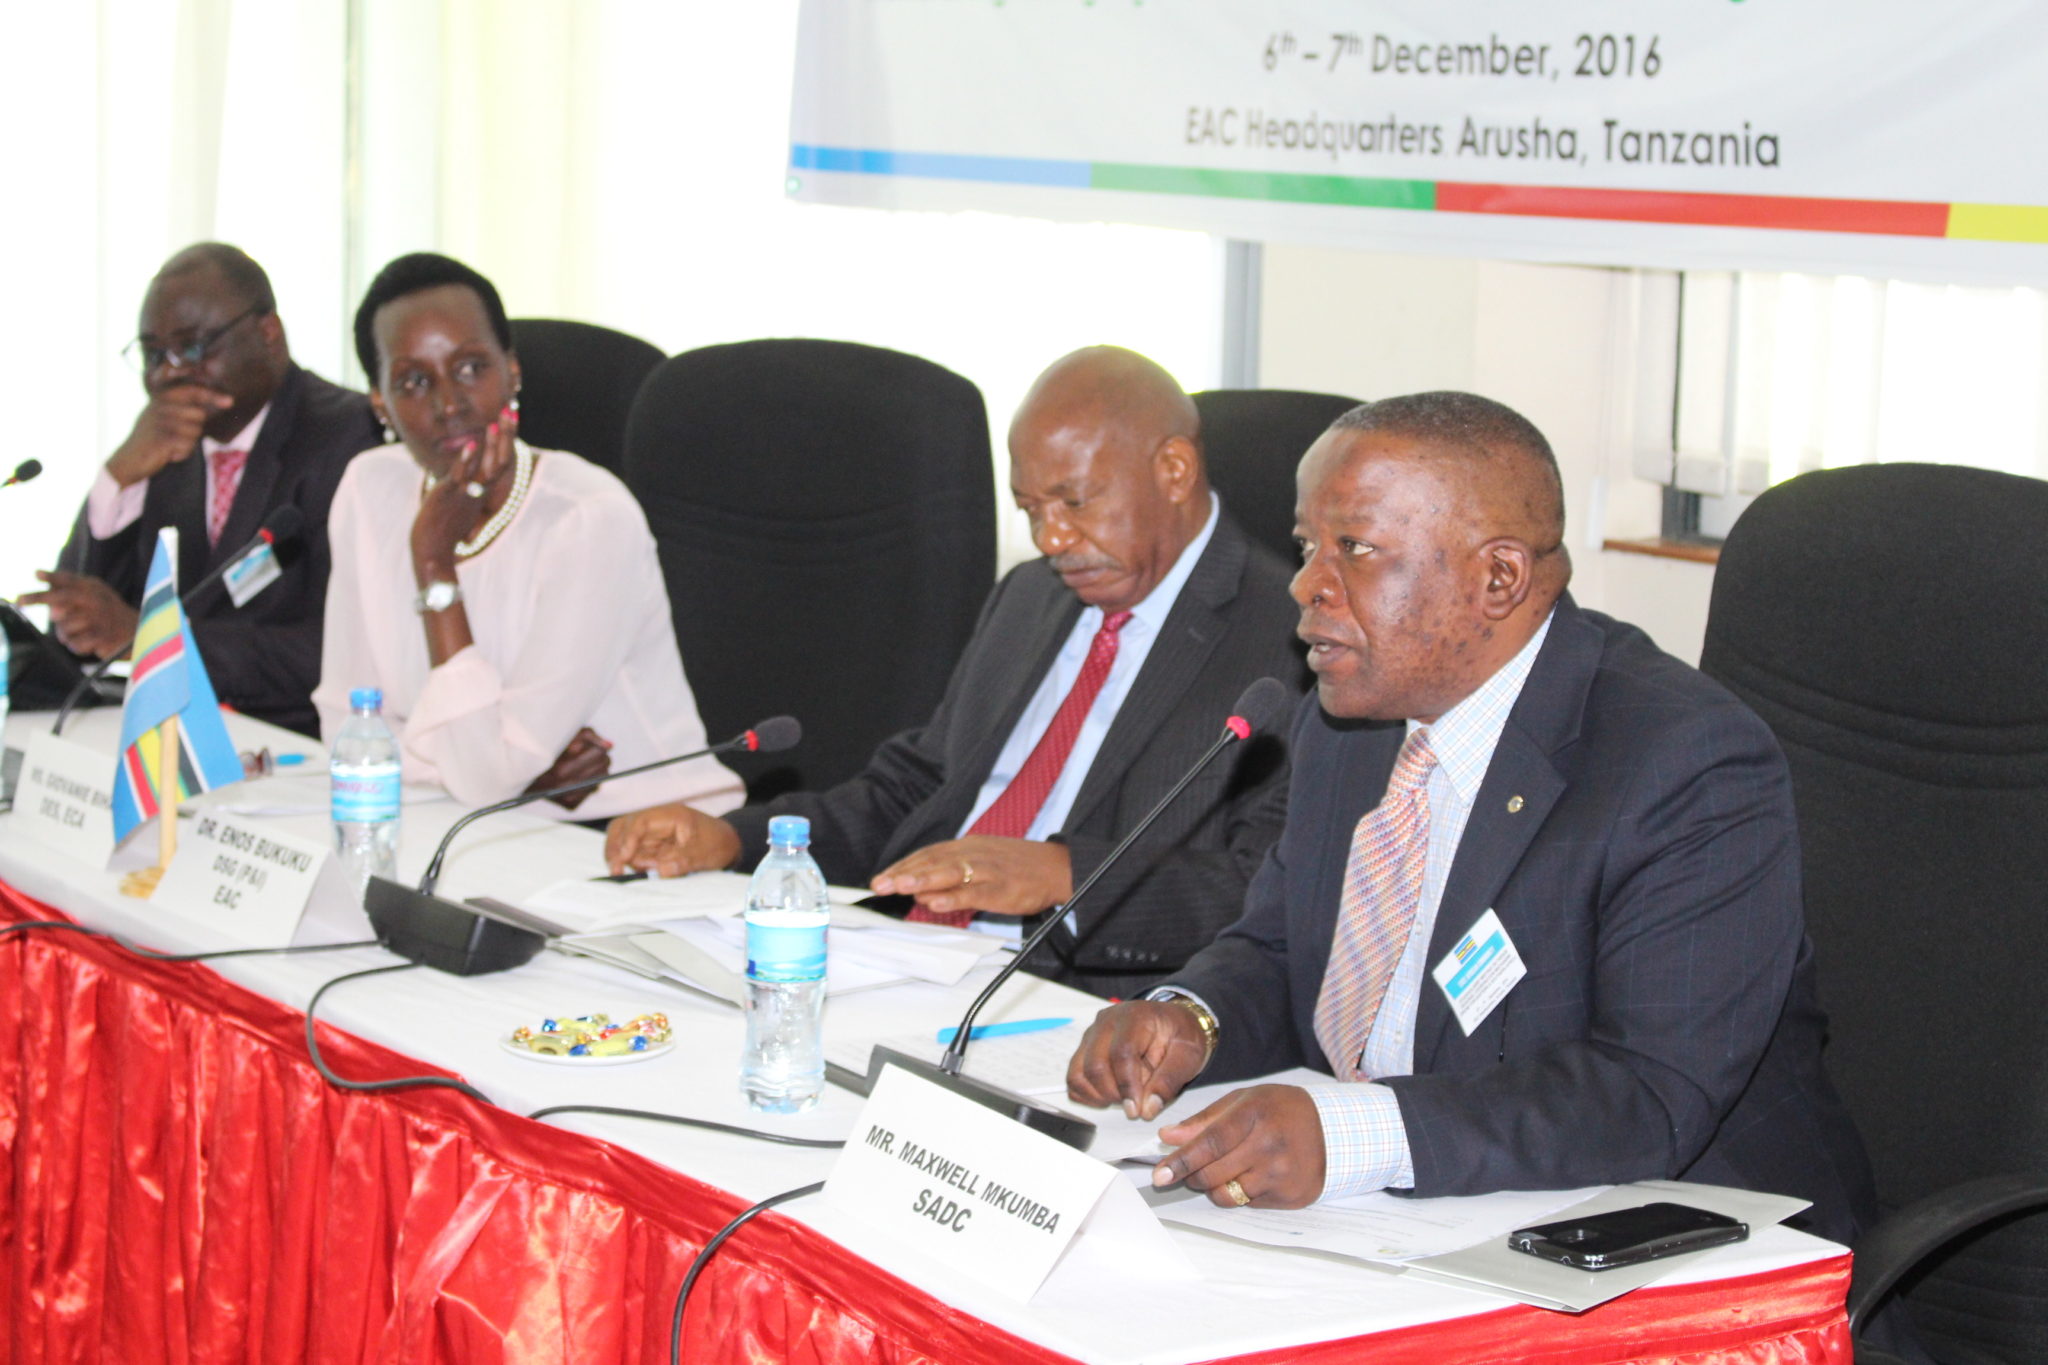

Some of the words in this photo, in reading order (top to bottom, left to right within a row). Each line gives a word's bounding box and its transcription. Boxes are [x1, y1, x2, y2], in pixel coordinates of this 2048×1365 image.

[1263, 32, 1297, 71] 6th
[1328, 33, 1362, 73] 7th
[1371, 33, 1561, 80] December,
[1574, 35, 1663, 78] 2016
[1185, 107, 1238, 146] EAC
[1457, 115, 1588, 166] Arusha,
[1603, 119, 1781, 167] Tanzania
[212, 854, 239, 876] DSG
[219, 825, 257, 852] ENOS
[254, 836, 313, 873] BUKUKU
[213, 885, 243, 910] EAC
[865, 1125, 895, 1155] MR.
[898, 1140, 980, 1195] MAXWELL
[980, 1181, 1061, 1234] MKUMBA
[912, 1188, 972, 1233] SADC
